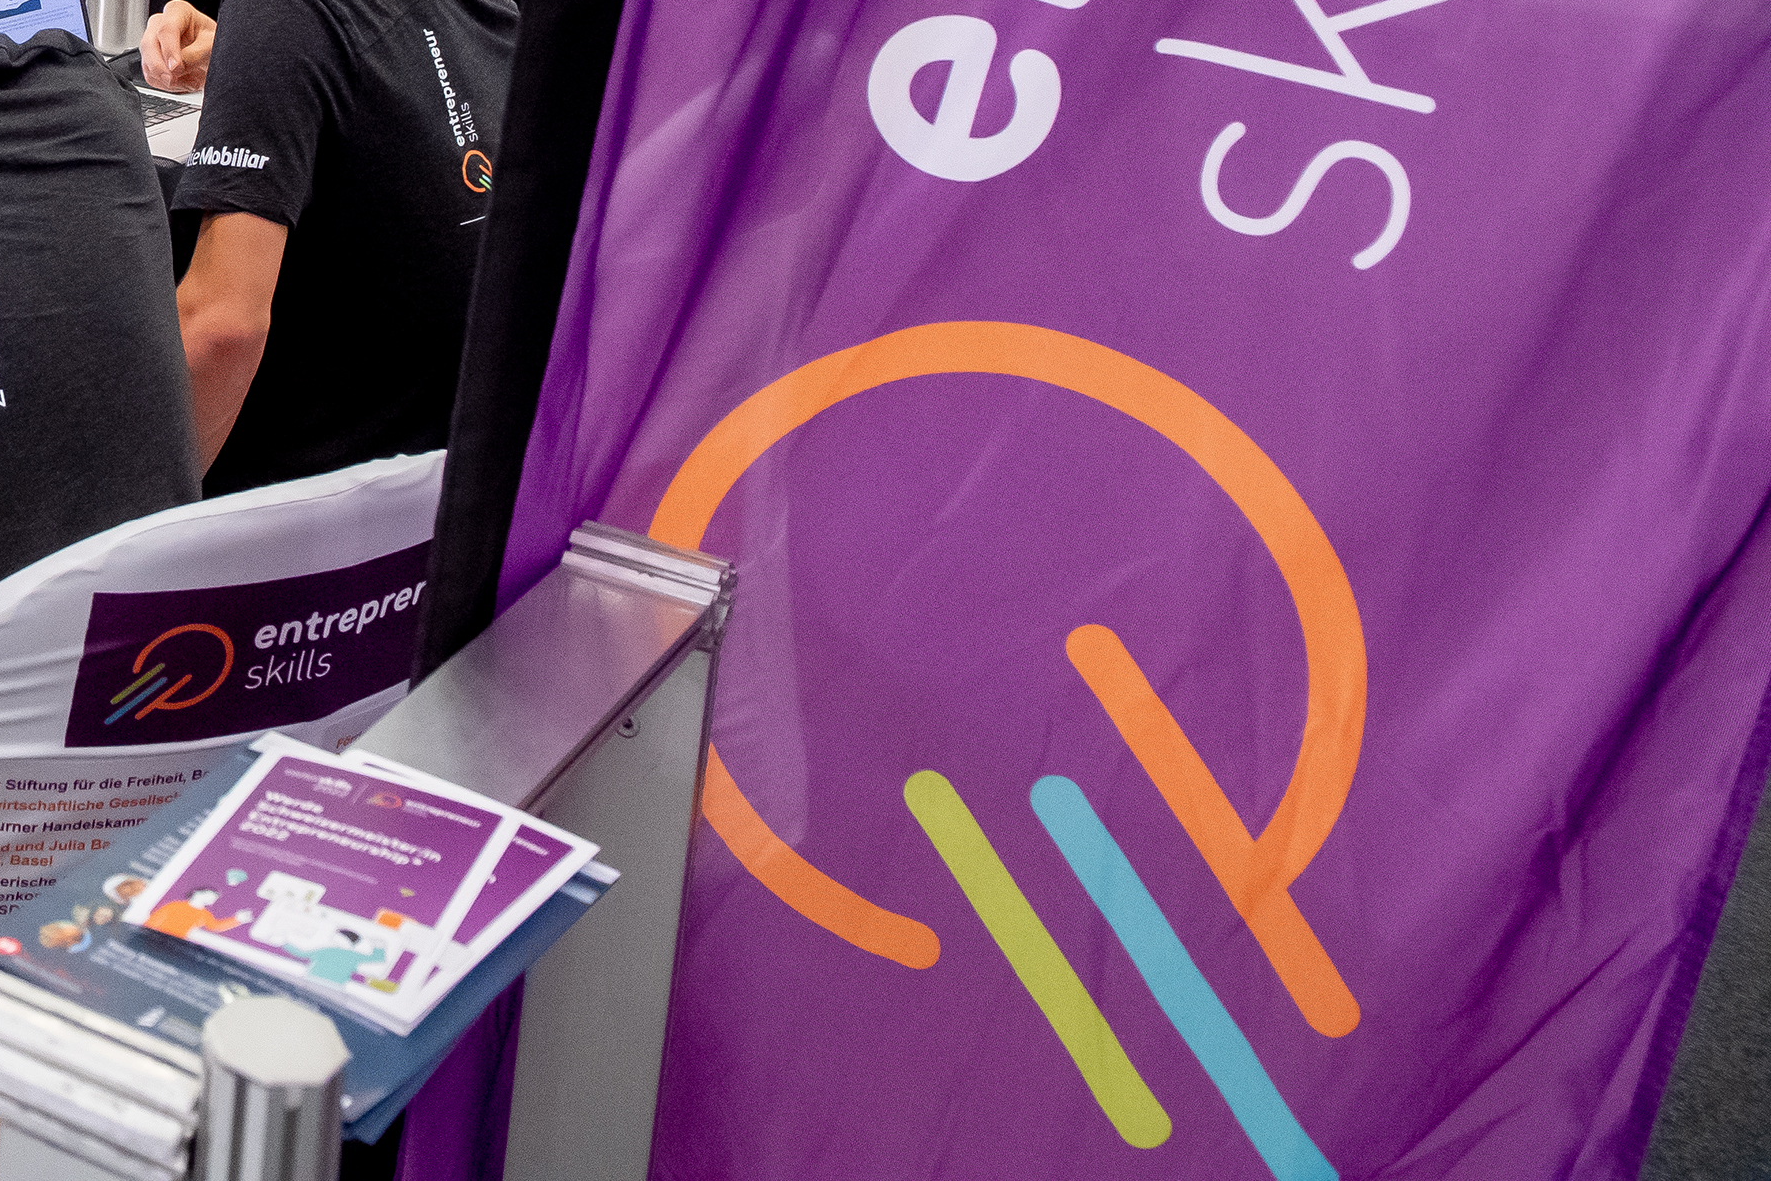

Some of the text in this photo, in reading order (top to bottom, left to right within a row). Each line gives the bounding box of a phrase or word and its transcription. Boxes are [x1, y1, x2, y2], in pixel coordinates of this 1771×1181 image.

[423, 28, 465, 147] entrepreneur
[456, 102, 479, 142] skills
[244, 648, 332, 689] skills
[5, 778, 68, 793] Stiftung
[73, 779, 96, 791] für
[99, 778, 122, 790] die
[127, 771, 187, 789] Freiheit,
[238, 820, 291, 841] 2022
[15, 840, 45, 852] und
[48, 839, 86, 852] Julia
[9, 855, 54, 866] Basel
